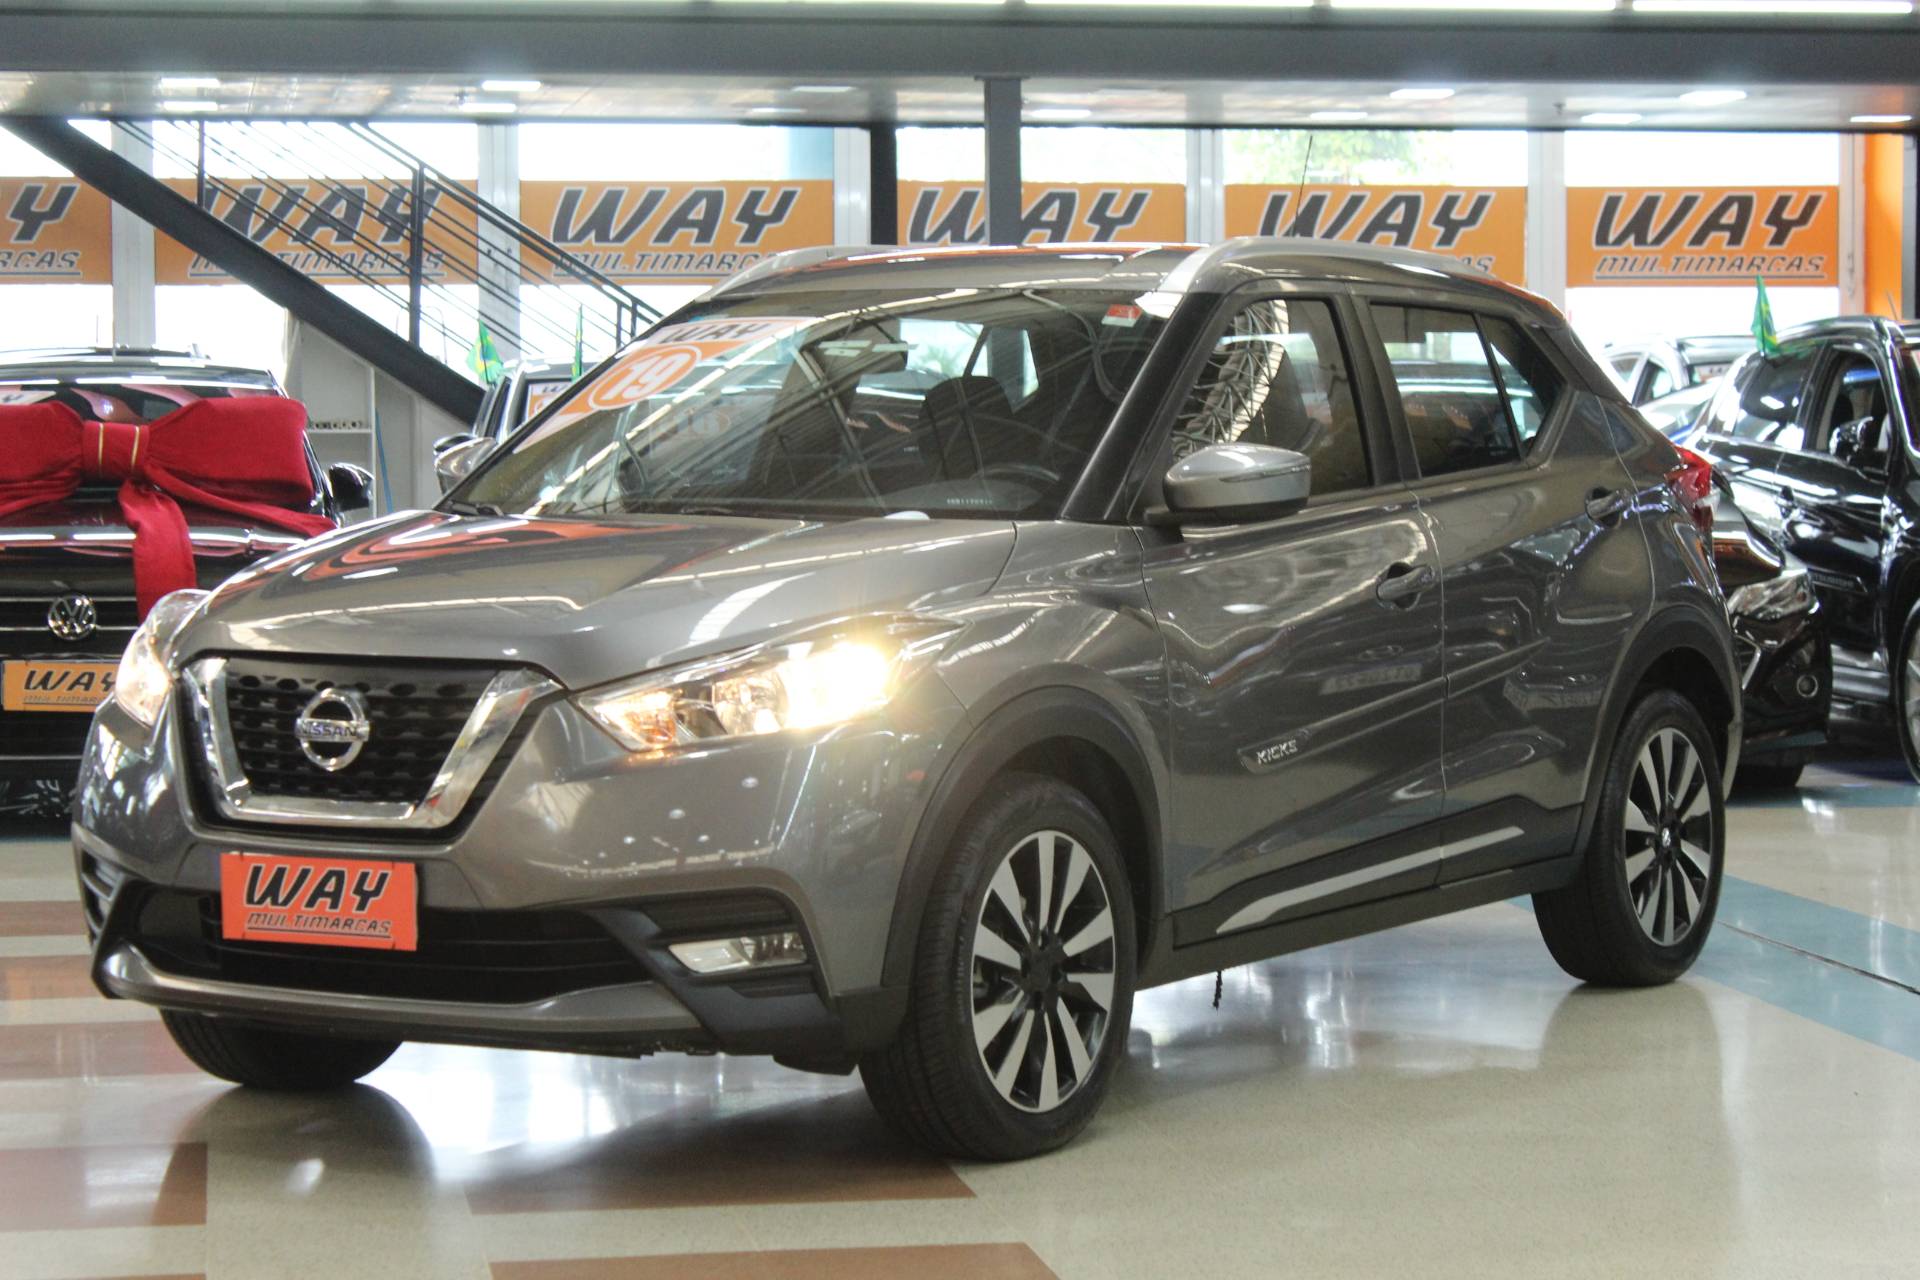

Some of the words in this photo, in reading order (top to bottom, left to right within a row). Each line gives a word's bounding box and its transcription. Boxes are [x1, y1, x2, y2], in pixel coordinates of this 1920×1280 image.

[552, 186, 801, 245] WAY
[908, 187, 1151, 243] WAY
[1260, 192, 1495, 248] WAY
[1594, 192, 1826, 249] WAY
[1596, 255, 1826, 273] MULTIMARCAS
[601, 353, 691, 399] 19
[302, 723, 358, 737] NISSAN
[1256, 739, 1298, 765] KICKS
[245, 864, 391, 913] WAY
[247, 912, 392, 934] MULTIMARCAS
